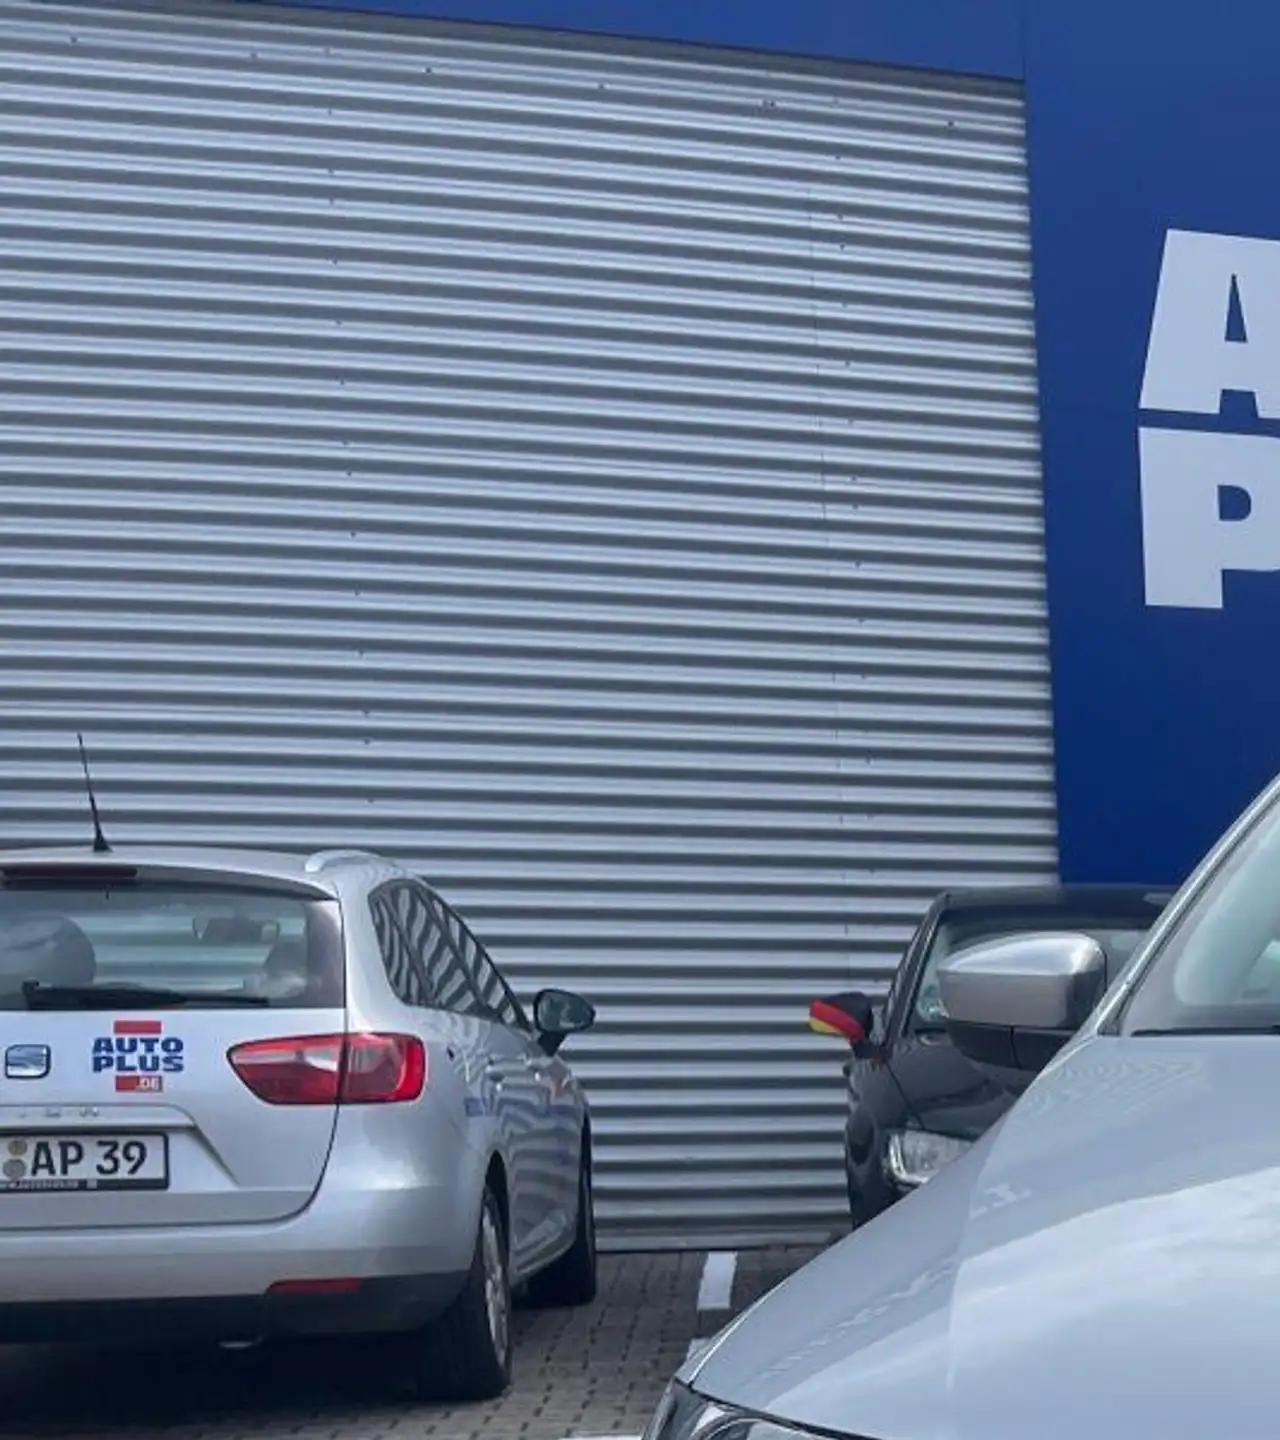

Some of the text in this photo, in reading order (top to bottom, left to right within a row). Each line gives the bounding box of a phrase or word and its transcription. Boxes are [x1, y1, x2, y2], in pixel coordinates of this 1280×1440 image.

[92, 1036, 184, 1054] AUTO
[92, 1055, 185, 1073] PLUS
[31, 1140, 148, 1176] AP 39
